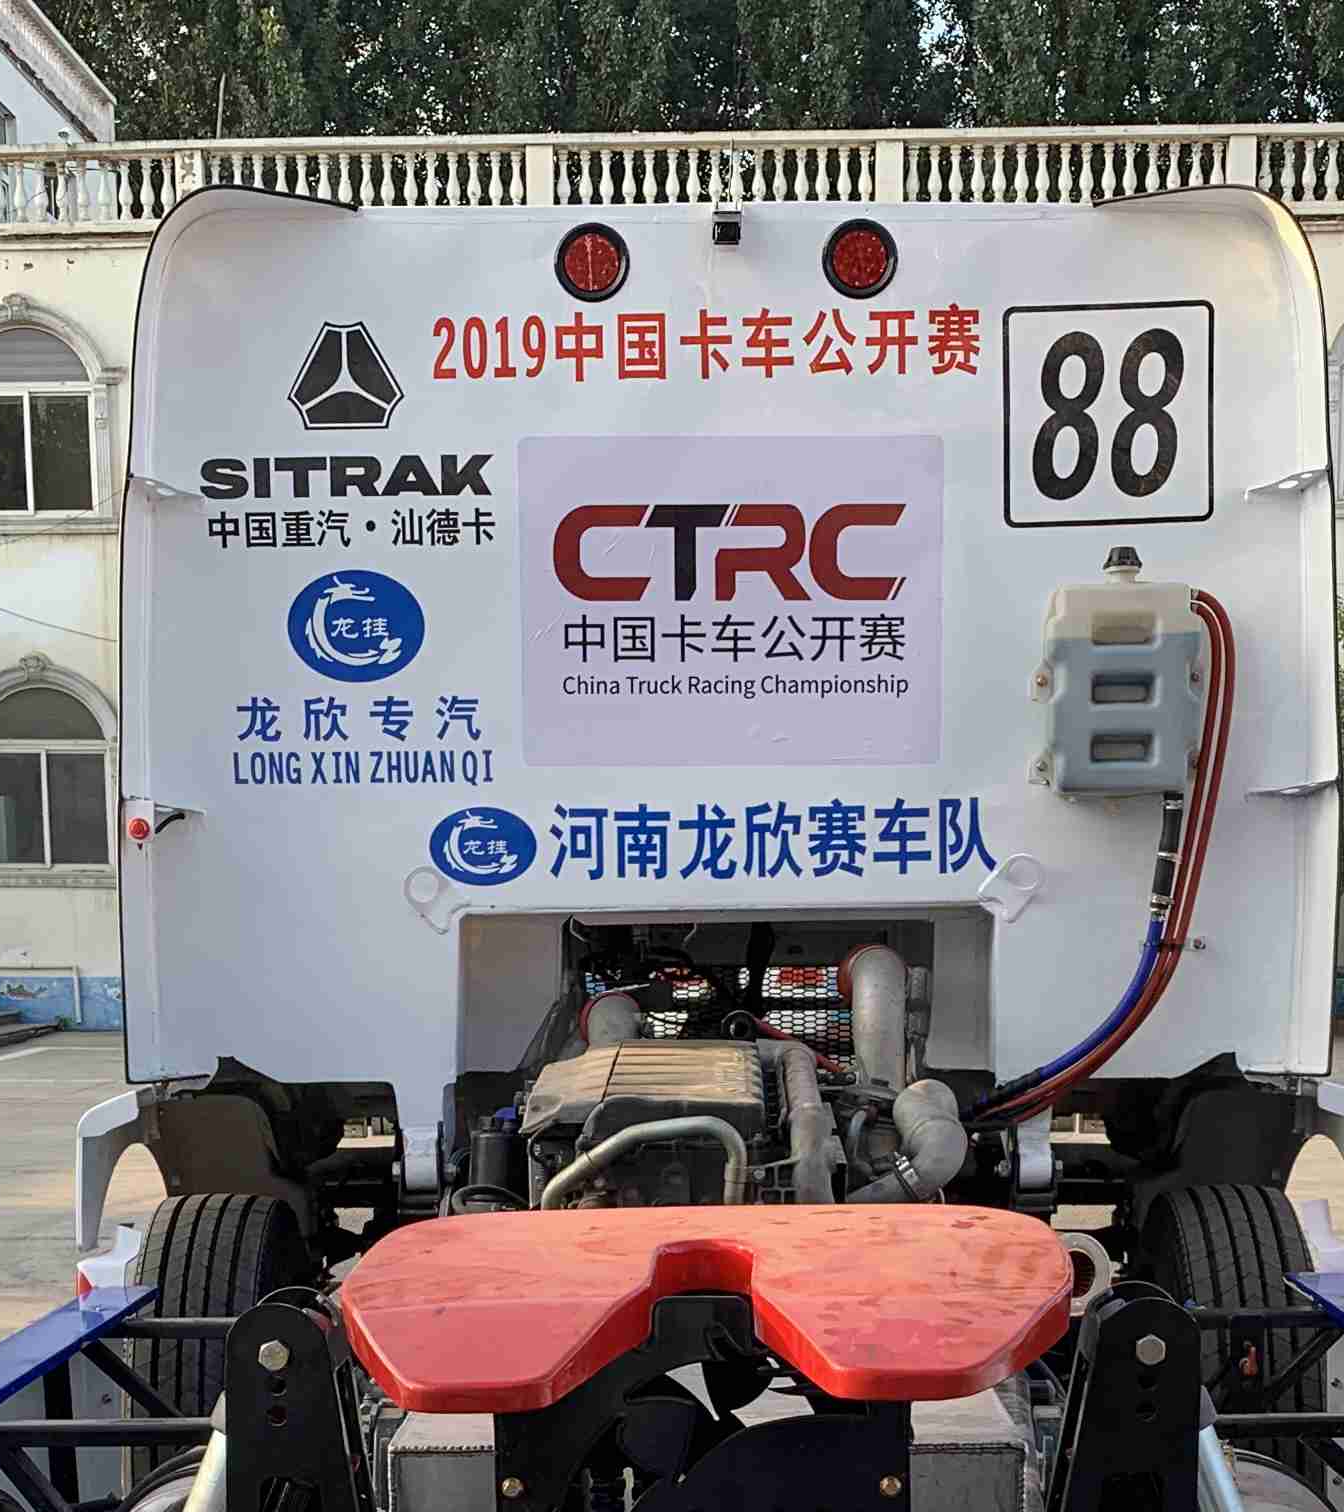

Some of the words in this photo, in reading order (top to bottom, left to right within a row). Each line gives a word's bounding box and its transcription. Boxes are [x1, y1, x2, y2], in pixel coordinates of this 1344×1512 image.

[432, 303, 981, 382] 2019中国卡车公开赛
[1033, 328, 1184, 500] 88
[200, 454, 494, 499] SITRAK
[553, 503, 907, 601] CTRC
[330, 617, 390, 639] 龙挂
[563, 614, 906, 663] 中国卡车公开赛
[562, 676, 620, 695] China
[627, 676, 681, 695] Truck
[688, 676, 756, 699] Racing
[761, 675, 909, 699] Championship
[236, 696, 481, 742] 龙欣专汽
[233, 752, 302, 784] LONG
[311, 752, 360, 784] XIN
[550, 798, 997, 880] 河南龙欣赛车队
